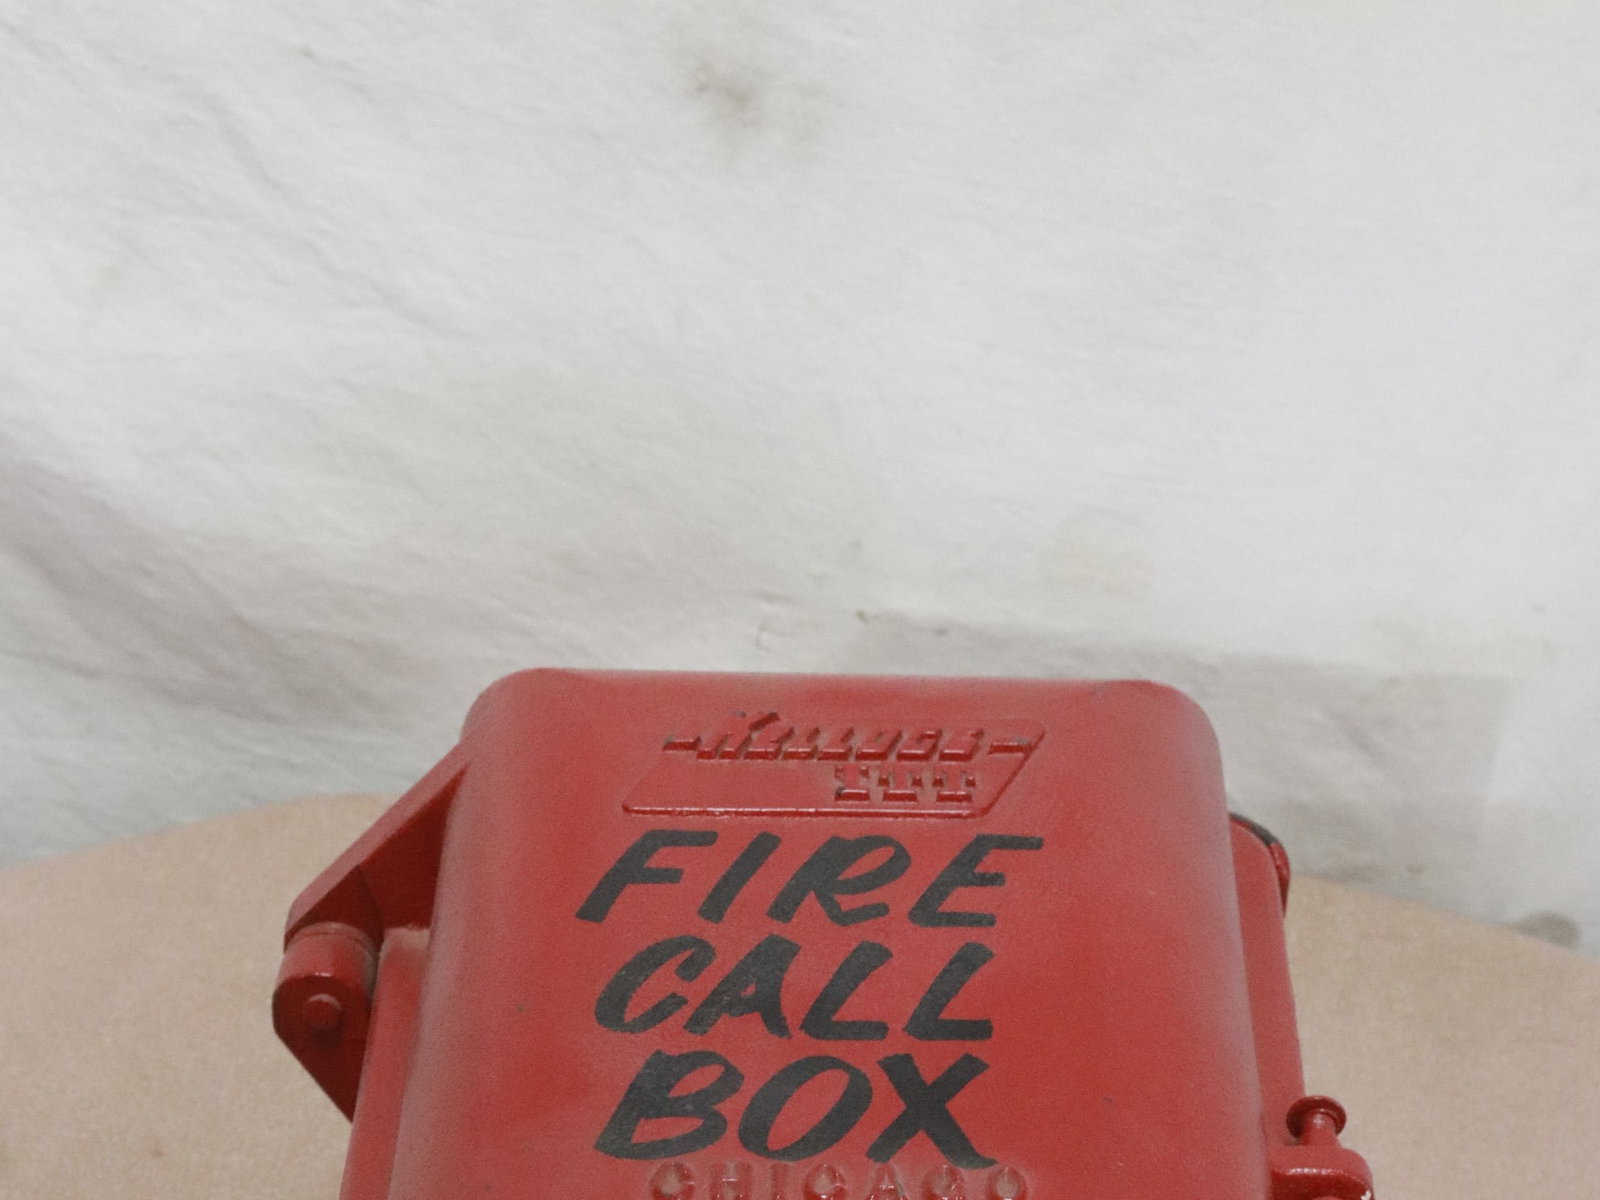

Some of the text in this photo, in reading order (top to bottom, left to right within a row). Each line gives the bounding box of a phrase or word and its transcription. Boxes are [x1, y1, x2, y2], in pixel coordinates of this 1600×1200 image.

[575, 829, 1044, 927] FIRE
[594, 933, 995, 1041] CALL
[593, 1050, 998, 1170] BOX
